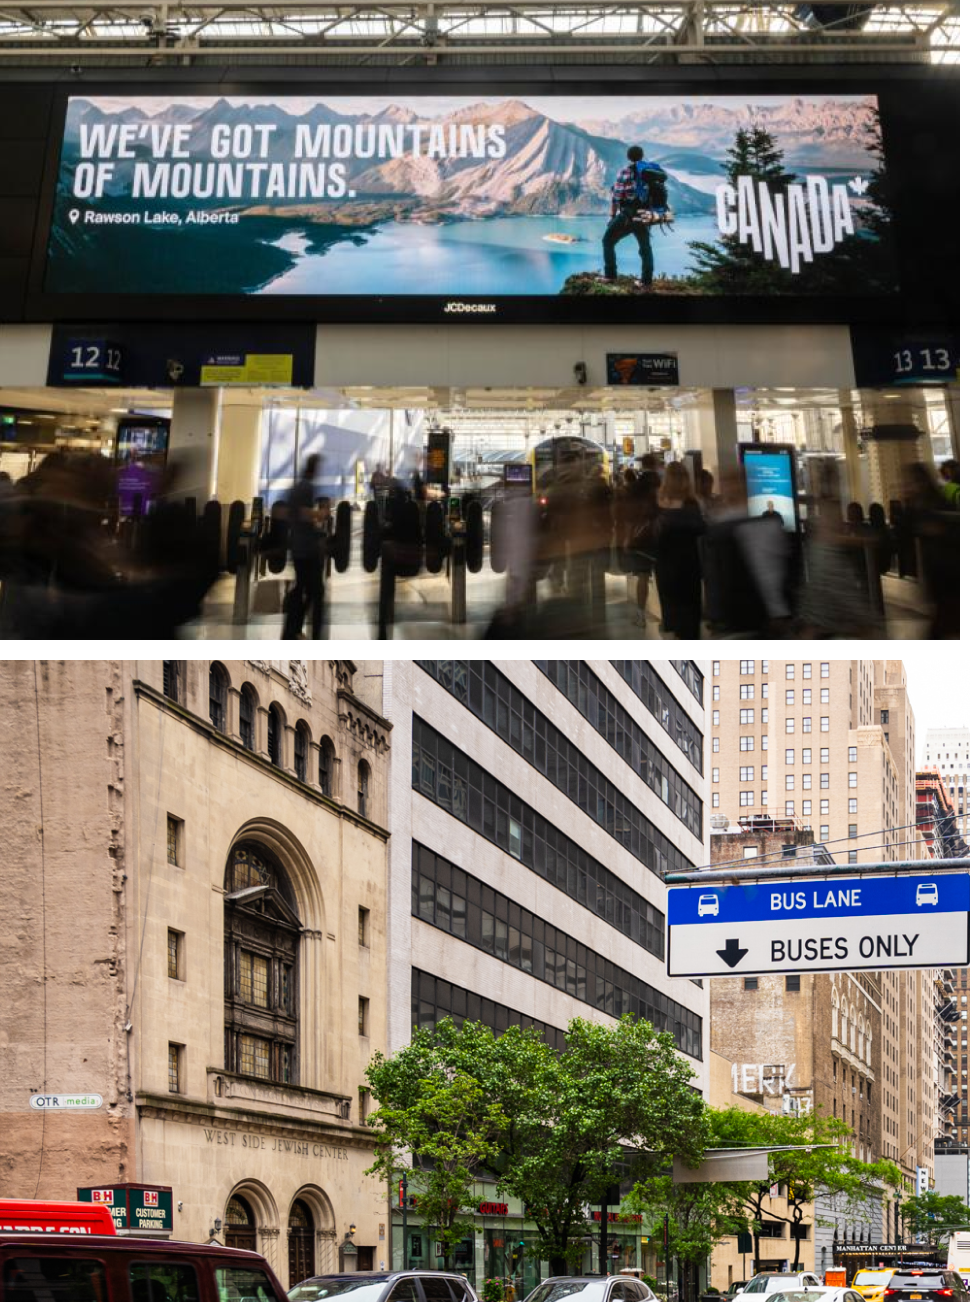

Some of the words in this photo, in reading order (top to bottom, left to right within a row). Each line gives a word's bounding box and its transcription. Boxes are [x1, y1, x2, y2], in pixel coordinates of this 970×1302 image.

[79, 123, 193, 159] WE'VE
[211, 124, 276, 159] GOT
[299, 124, 507, 159] MOUNTAINS
[73, 162, 113, 198] OF
[132, 162, 357, 198] MOUNTAINS.
[84, 210, 141, 225] Rawson
[144, 210, 183, 227] Lake,
[185, 210, 239, 225] Alberta
[716, 174, 856, 274] CANADA
[444, 302, 496, 314] JCDecaux
[70, 346, 100, 369] 12
[106, 347, 121, 372] 12
[894, 349, 913, 373] 13
[920, 348, 950, 371] 13
[769, 892, 807, 912] BUS
[812, 888, 862, 909] LANE
[770, 936, 849, 963] BUSES
[859, 933, 920, 959] ONLY
[36, 1096, 60, 1107] OTR
[66, 1096, 96, 1105] media
[203, 1128, 237, 1146] WEST
[242, 1133, 266, 1151] SIDE
[272, 1138, 309, 1156] JEWISH
[312, 1143, 349, 1161] CENTER
[135, 1207, 166, 1219] CUSTOMER
[479, 1201, 509, 1216] GUITARS
[138, 1219, 164, 1230] PARKING
[836, 1244, 878, 1252] MANHATTAN
[879, 1244, 907, 1252] CENTER
